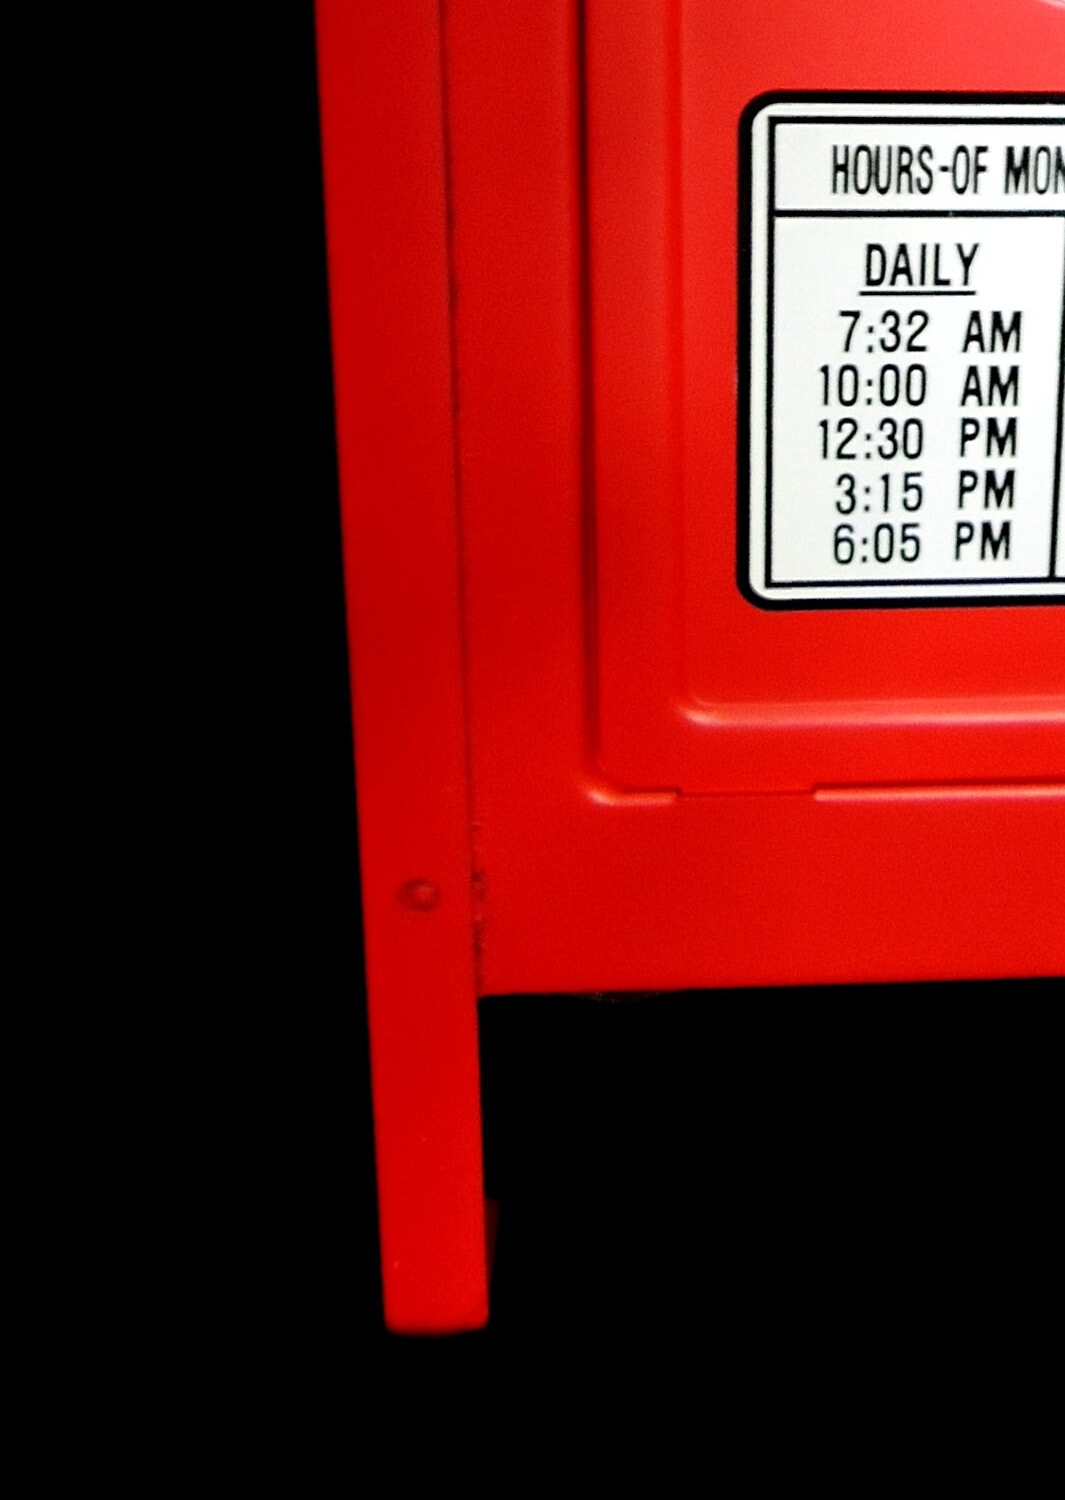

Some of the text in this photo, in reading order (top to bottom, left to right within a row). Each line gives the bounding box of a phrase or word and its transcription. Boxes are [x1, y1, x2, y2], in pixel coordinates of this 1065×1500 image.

[864, 242, 979, 287] DAILY
[839, 309, 1022, 354] 7:32 AM
[819, 363, 1020, 407] 10:00 AM
[819, 416, 1018, 461] 12:30 PM
[835, 469, 1016, 516] 3:15 PM
[833, 520, 1012, 566] 6:05 PM
